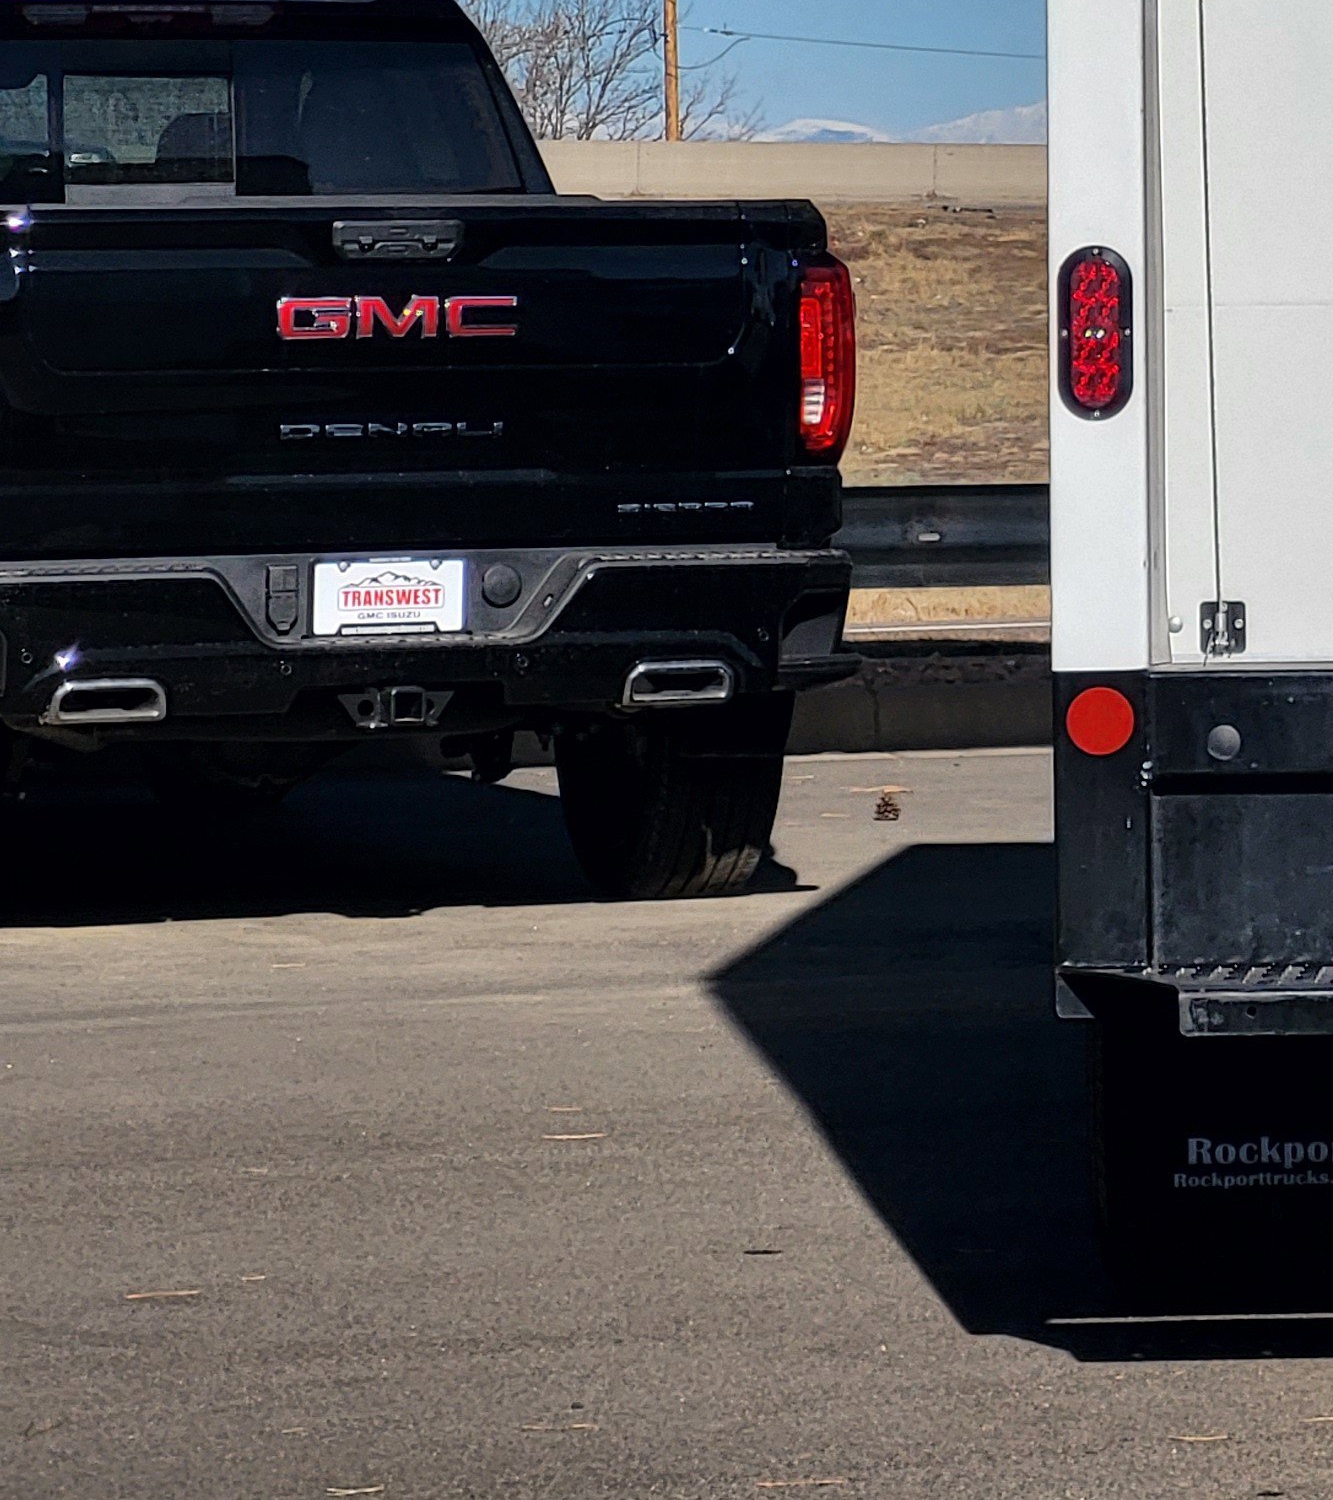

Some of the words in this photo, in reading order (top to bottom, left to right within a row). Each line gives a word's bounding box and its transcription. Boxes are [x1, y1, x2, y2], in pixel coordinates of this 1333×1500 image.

[277, 295, 518, 339] GMC
[342, 588, 442, 607] TRANSWEST
[357, 612, 385, 620] GMC
[387, 611, 421, 619] ISUZU
